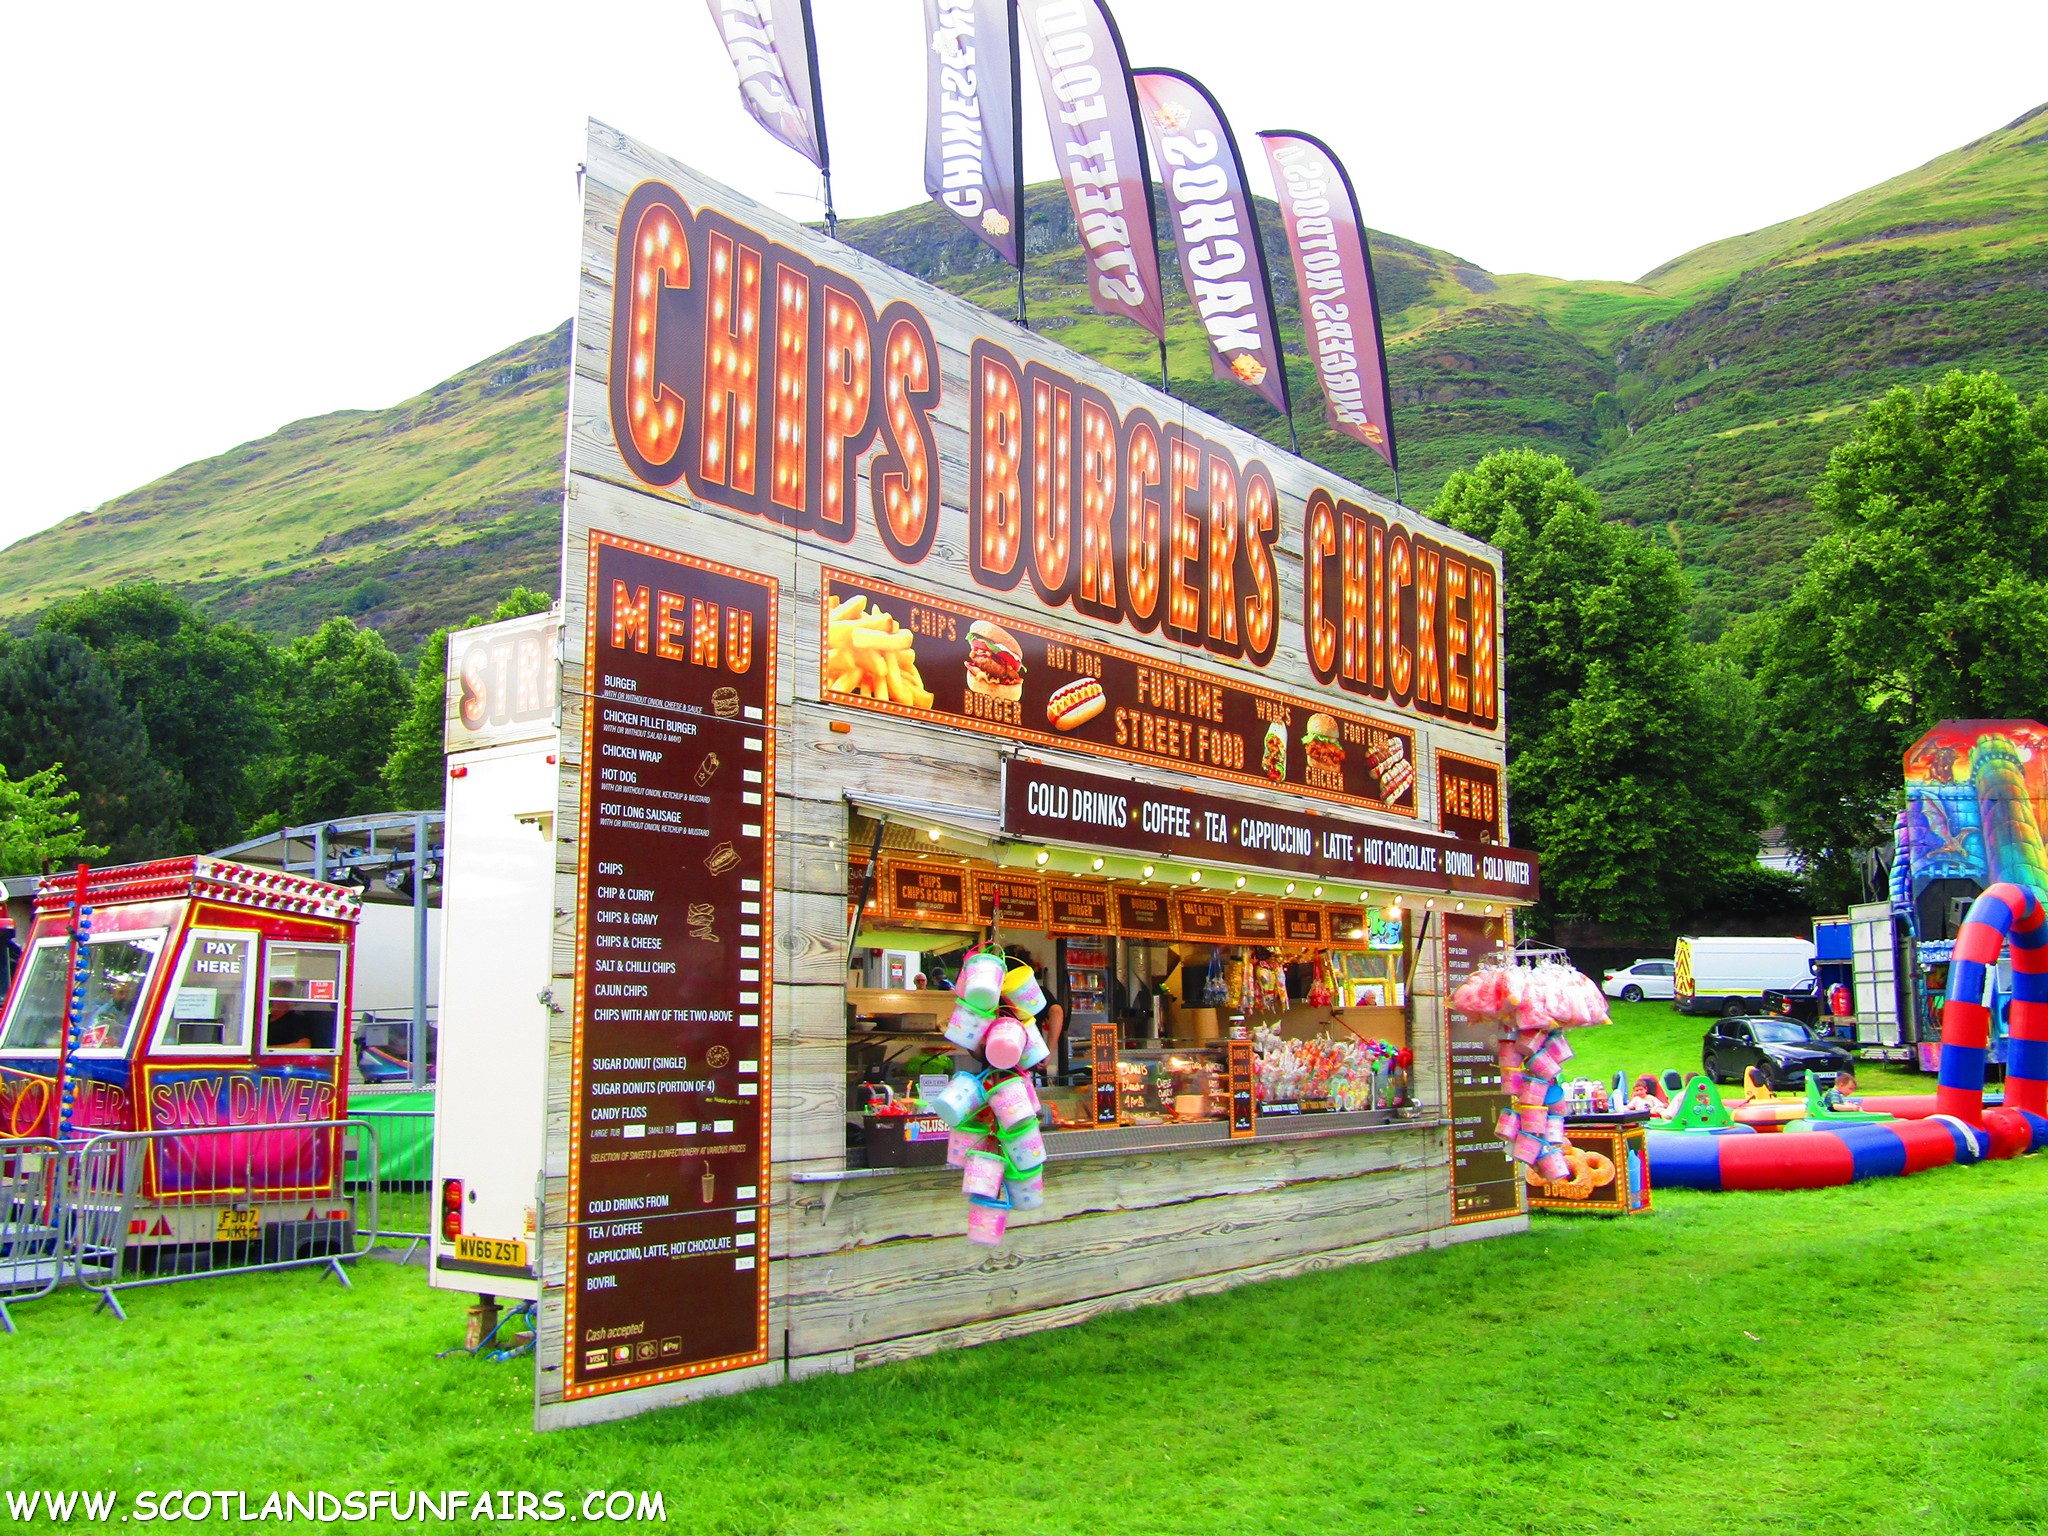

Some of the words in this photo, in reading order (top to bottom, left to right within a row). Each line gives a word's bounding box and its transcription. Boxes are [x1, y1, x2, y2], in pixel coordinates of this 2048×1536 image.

[624, 202, 929, 547] CHIPS
[980, 355, 1273, 654] BURGERS
[1310, 501, 1493, 720] CHICKEN
[611, 579, 752, 674] MENU
[909, 607, 956, 642] CHIPS
[1047, 644, 1073, 672] HOT
[1076, 652, 1102, 678] DOG
[605, 675, 637, 691] BURGER
[1137, 665, 1223, 723] FUNTIME
[963, 689, 1023, 726] BURGER
[1255, 699, 1292, 726] WRAPS
[604, 709, 638, 726] CHICKEN
[641, 715, 665, 730] FILLET
[667, 720, 697, 735] BURGER
[1114, 706, 1193, 759] STREET
[1198, 725, 1245, 770] FOOD
[1344, 722, 1366, 745] FOOT
[1368, 730, 1390, 750] LONG
[602, 744, 637, 760] CHICKEN
[639, 750, 663, 764] WRAP
[602, 768, 618, 781] HOT
[620, 770, 637, 783] DOG
[1305, 766, 1344, 792] CHICKEN
[1444, 773, 1493, 823] MENU
[601, 803, 621, 816] FOOT
[623, 806, 644, 819] LONG
[646, 809, 682, 824] SAUSAGE
[1028, 781, 1069, 819] COLD
[1072, 790, 1127, 828] DRINKS
[1142, 800, 1191, 838] COFFEE
[1205, 811, 1228, 844] TEA
[1240, 818, 1311, 856] CAPPUCCINO
[1323, 832, 1354, 862] LATTE
[1363, 838, 1383, 865] HOT
[1385, 842, 1436, 873] CHOCOLATE
[1445, 850, 1475, 878] BOVRIL
[1483, 856, 1503, 881] COLD
[1505, 860, 1530, 885] WATER
[598, 862, 623, 876] CHIPS
[918, 874, 941, 889] CHIPS
[598, 886, 617, 899] CHIP
[619, 888, 626, 899] &
[627, 889, 654, 902] CURRY
[902, 886, 925, 900] CHIPS
[932, 890, 958, 904] CURRY
[1011, 885, 1037, 900] WRAPS
[1054, 891, 1081, 904] CHICKEN
[1082, 893, 1104, 906] FILLET
[1068, 904, 1093, 917] BURGER
[1184, 903, 1198, 915] SALT
[597, 911, 621, 924] CHIPS
[623, 912, 630, 924] &
[632, 913, 658, 926] GRAVY
[207, 943, 237, 955] PAY
[596, 935, 621, 948] CHIPS
[623, 937, 629, 948] &
[631, 938, 662, 950] CHEESE
[197, 960, 240, 974] HERE
[596, 959, 615, 972] SALT
[617, 961, 624, 972] &
[625, 961, 650, 973] CHILLI
[653, 962, 676, 974] CHIPS
[595, 984, 622, 996] CAJUN
[624, 985, 648, 997] CHIPS
[594, 1009, 619, 1021] CHIPS
[621, 1010, 642, 1021] WITH
[644, 1010, 660, 1021] ANY
[662, 1010, 672, 1021] OF
[674, 1010, 688, 1021] THE
[690, 1010, 707, 1021] TWO
[709, 1011, 733, 1022] ABOVE
[1097, 1034, 1113, 1046] SALT
[593, 1058, 622, 1070] SUGAR
[623, 1057, 651, 1070] DONUT
[653, 1057, 687, 1070] (SINGLE)
[592, 1083, 621, 1095] SUGAR
[623, 1081, 656, 1094] DONUTS
[657, 1081, 694, 1095] (PORTION
[695, 1080, 705, 1092] OF
[707, 1080, 715, 1093] 4)
[151, 1078, 222, 1126] SKY
[228, 1076, 336, 1126] DIVER
[591, 1108, 619, 1120] CANDY
[621, 1106, 647, 1119] FLOSS
[591, 1129, 608, 1138] LARGE
[610, 1128, 620, 1137] TUB
[648, 1126, 664, 1135] SMALL
[665, 1125, 674, 1134] TUB
[702, 1124, 712, 1132] BAG
[590, 1152, 621, 1163] SELECTION
[621, 1151, 630, 1161] OF
[630, 1150, 651, 1161] SWEETS
[658, 1147, 699, 1159] CONFECTIONERY
[707, 1146, 728, 1155] VARIOUS
[729, 1144, 747, 1153] PRICES
[589, 1200, 612, 1213] COLD
[613, 1197, 644, 1211] DRINKS
[646, 1195, 669, 1208] FROM
[223, 1210, 256, 1223] FJ07
[588, 1226, 604, 1239] TEA
[612, 1222, 643, 1237] COFFEE
[460, 1238, 492, 1259] WV66
[495, 1242, 520, 1262] ZST
[588, 1247, 642, 1265] CAPPUCCINO,
[643, 1243, 669, 1258] LATTE,
[671, 1241, 686, 1255] HOT
[687, 1236, 731, 1253] CHOCOLATE
[587, 1275, 618, 1290] BOVRIL
[586, 1327, 607, 1342] Cash
[607, 1320, 644, 1339] accepted
